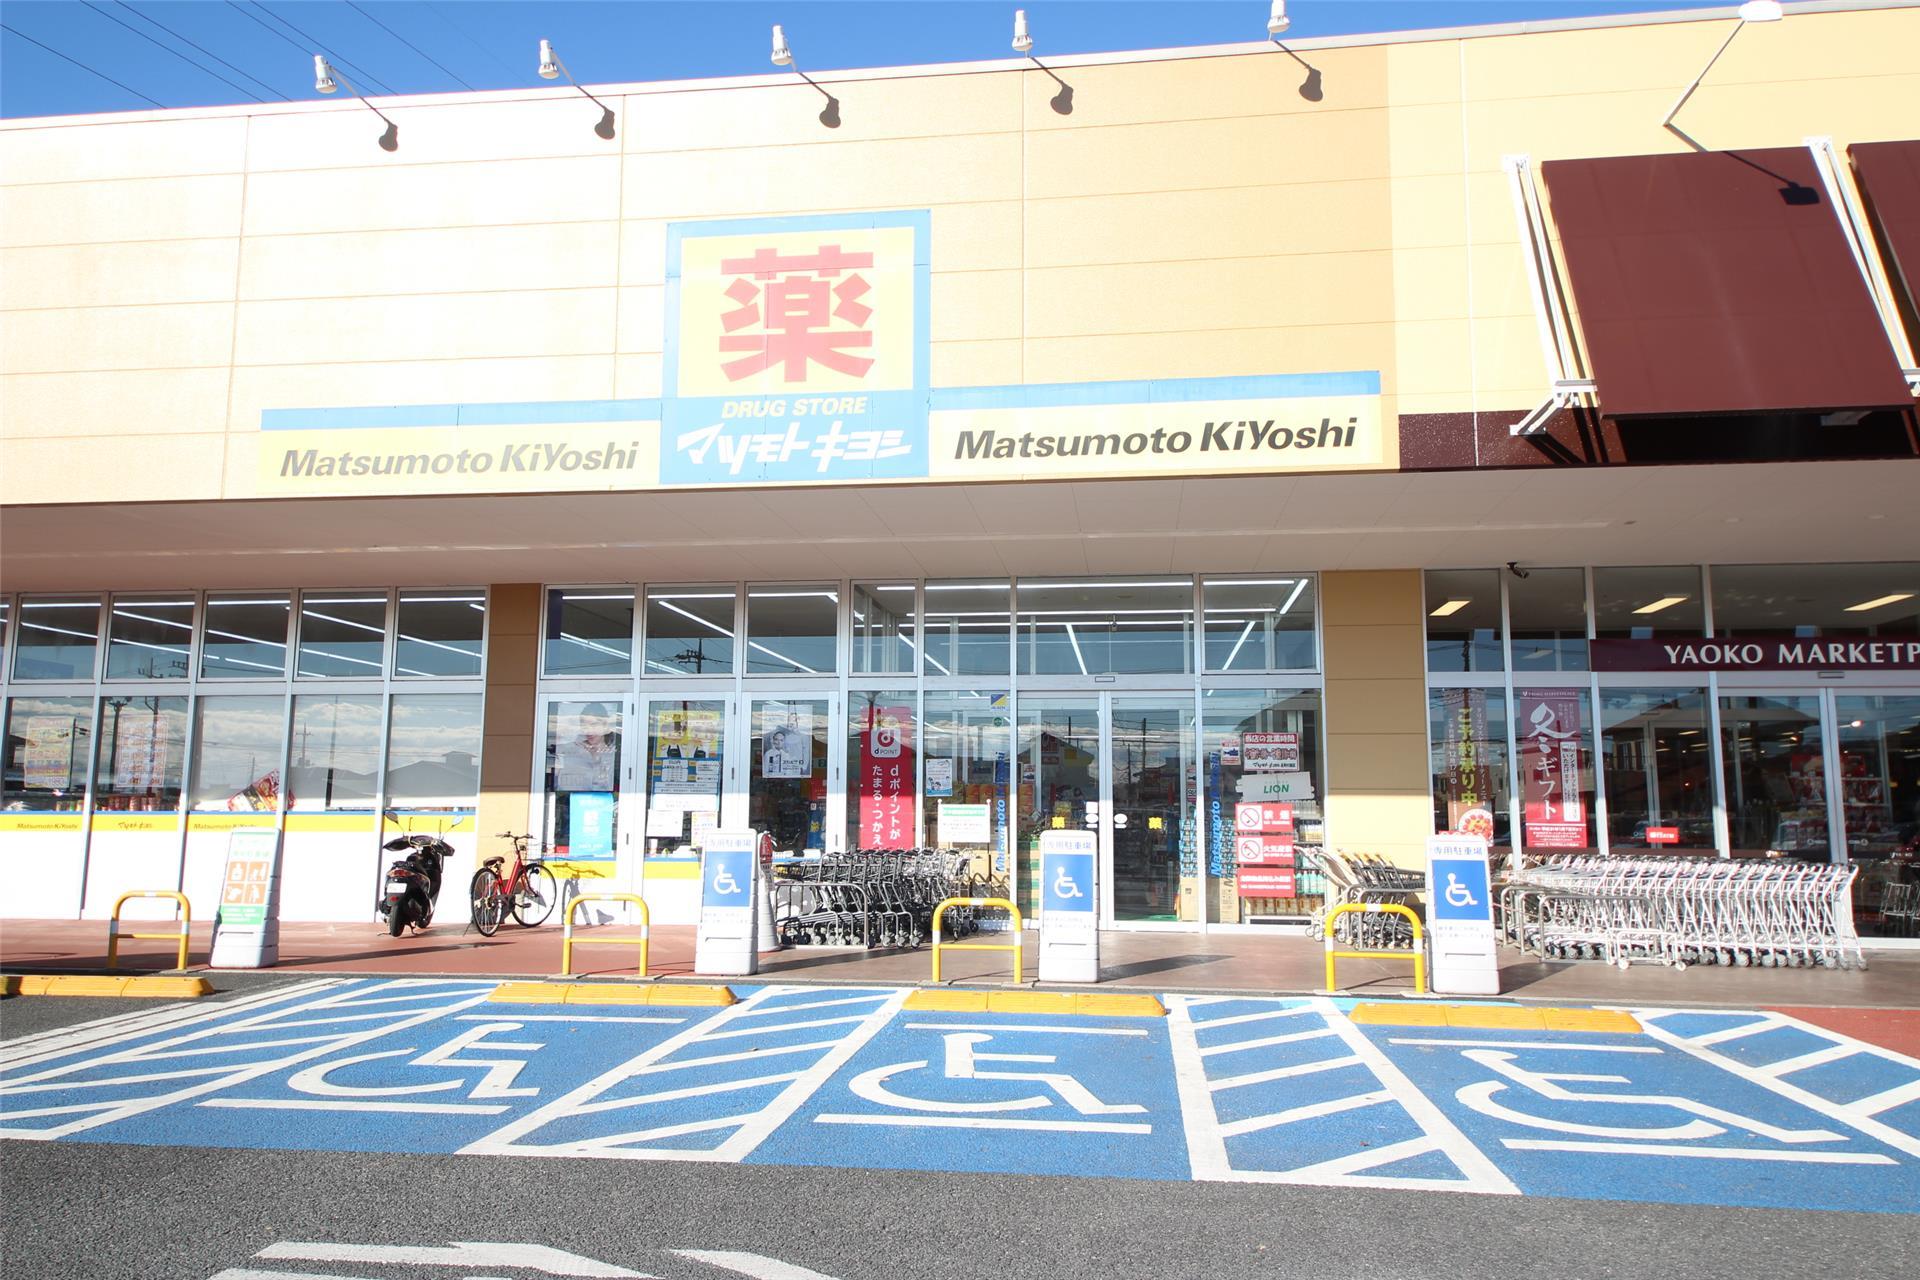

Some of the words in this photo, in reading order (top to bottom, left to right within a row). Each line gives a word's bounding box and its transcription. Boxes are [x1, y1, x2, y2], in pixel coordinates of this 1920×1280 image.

[719, 245, 874, 382] 薬
[721, 400, 787, 418] DRUG
[792, 396, 867, 416] STORE
[281, 448, 493, 477] Matsumoto
[499, 441, 639, 472] KiYoshi
[677, 420, 912, 475] マツモトキヨシ
[954, 427, 1192, 460] Matsumoto
[1200, 417, 1358, 452] KiYoshi
[1664, 644, 1763, 664] YAOKO
[1528, 702, 1576, 820] 冬ギフト
[872, 764, 883, 847] たまる・つかえ
[889, 764, 901, 840] dポイントが
[1263, 784, 1290, 794] LION
[1210, 801, 1221, 877] Matsumoto
